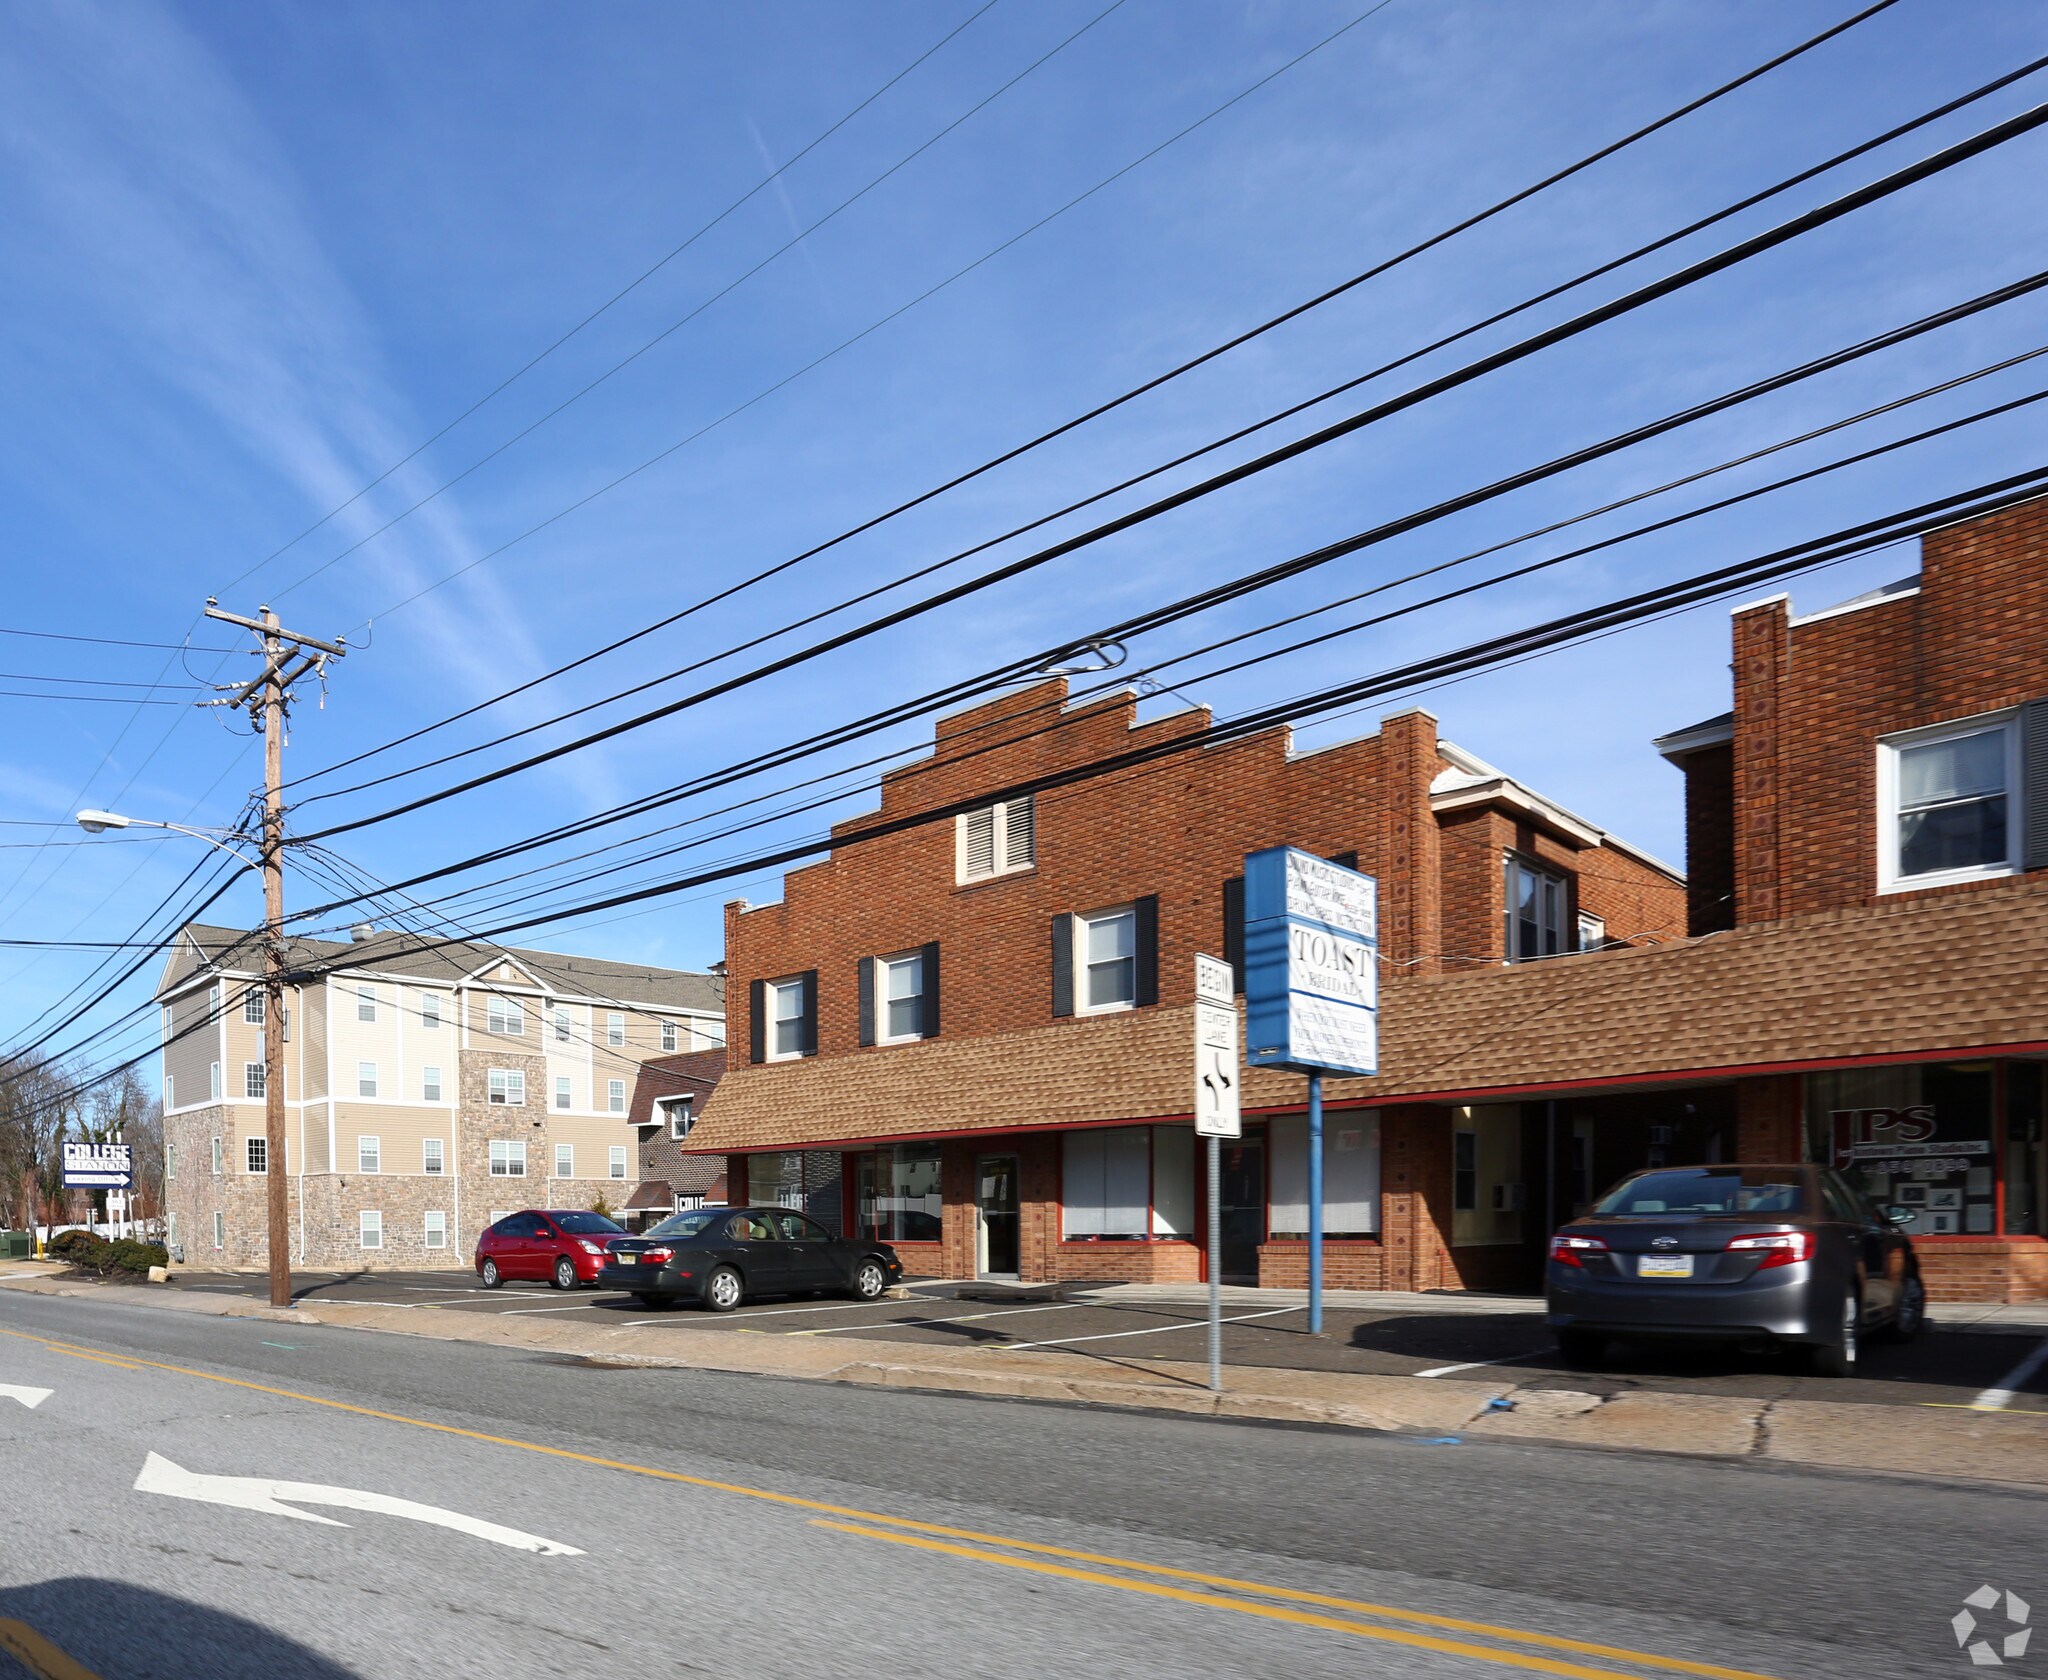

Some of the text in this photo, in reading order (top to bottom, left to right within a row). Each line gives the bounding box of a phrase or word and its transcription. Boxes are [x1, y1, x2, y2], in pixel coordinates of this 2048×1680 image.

[1293, 930, 1371, 977] TOAST
[1200, 964, 1232, 996] BEGIN
[1308, 971, 1358, 997] BRIDAL
[1202, 1011, 1232, 1027] CENTER
[1206, 1030, 1227, 1043] LANE
[64, 1143, 130, 1160] COLLEGE
[67, 1161, 129, 1170] STATION
